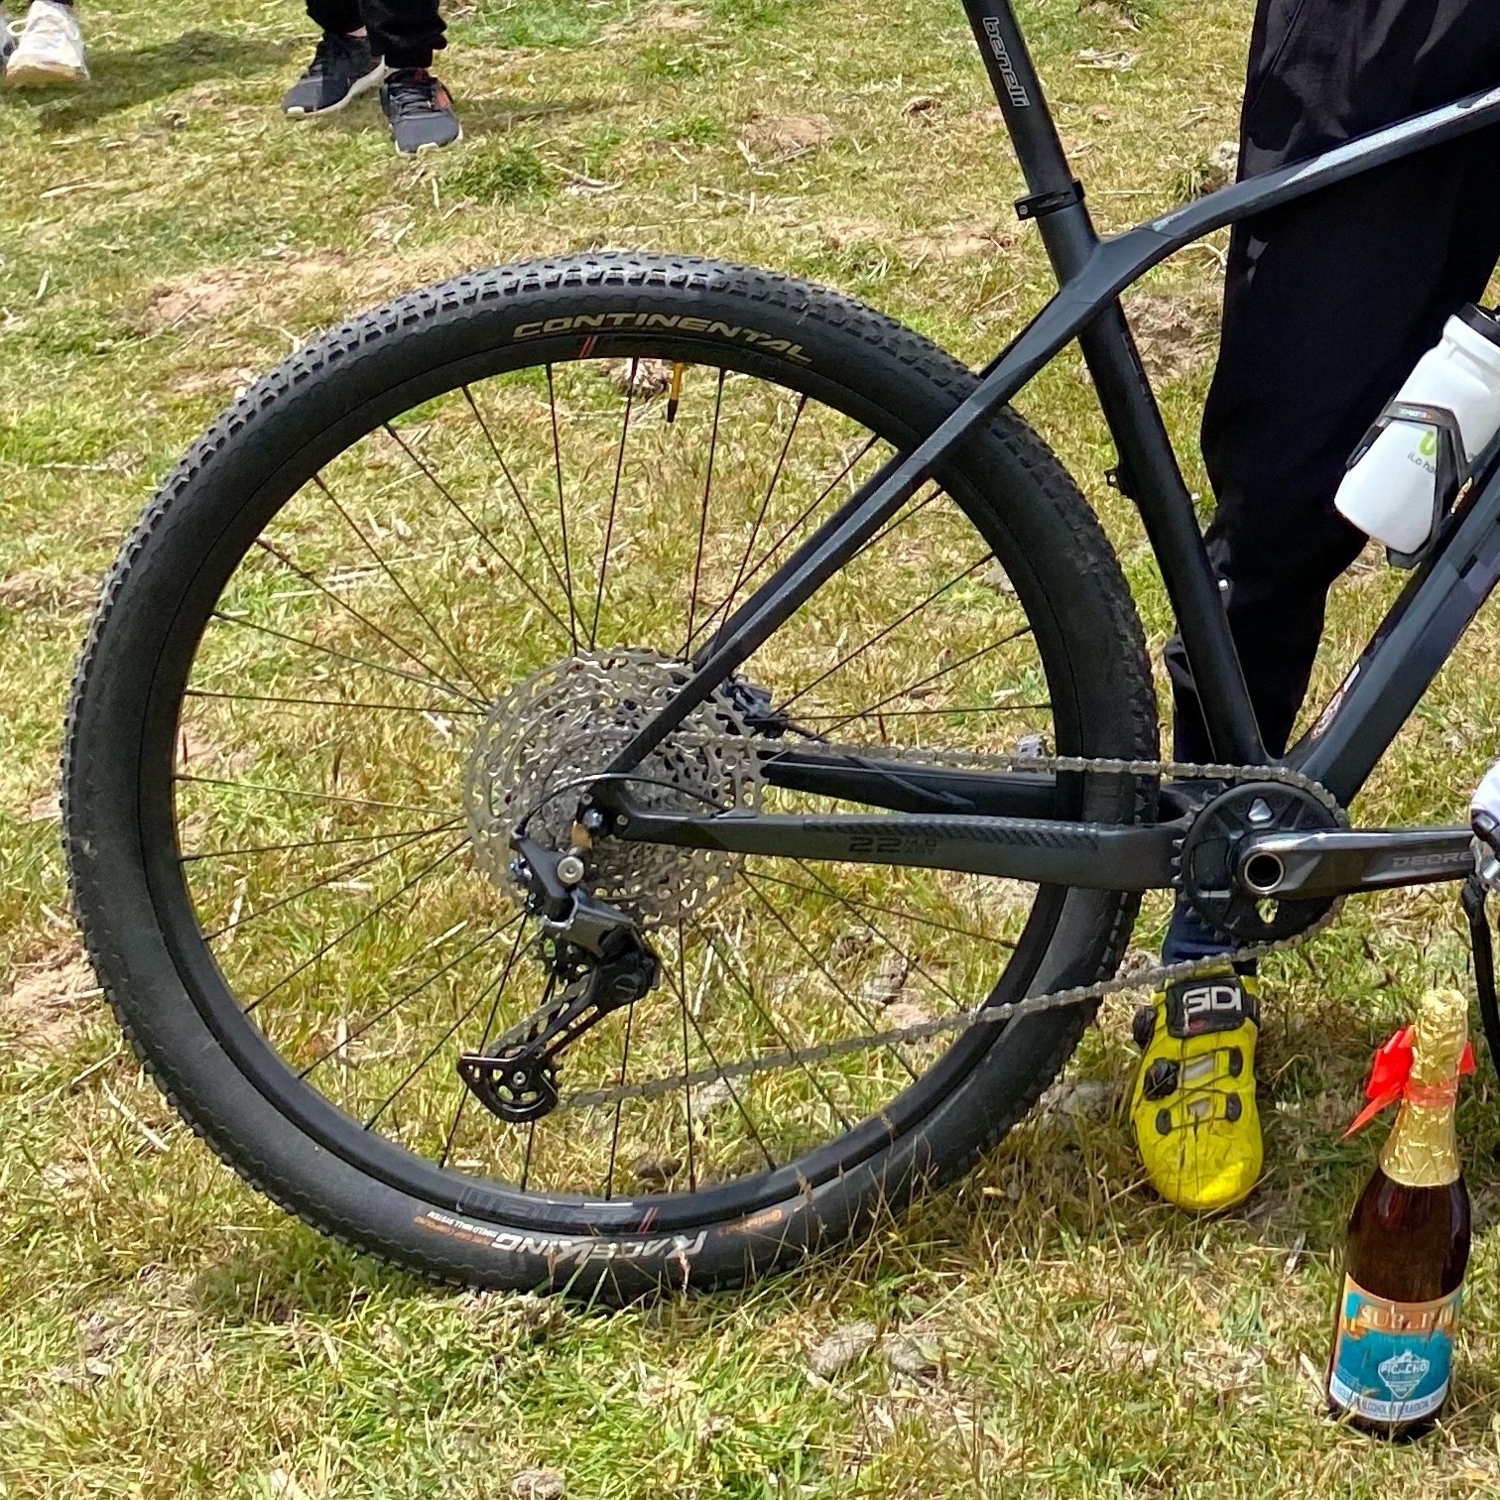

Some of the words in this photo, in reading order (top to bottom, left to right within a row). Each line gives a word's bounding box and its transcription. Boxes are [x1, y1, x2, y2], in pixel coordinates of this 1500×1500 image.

[982, 16, 1031, 107] benelli
[512, 312, 813, 363] CONTINENTAL
[1392, 851, 1474, 868] DEORE
[1182, 985, 1243, 1014] SIDI
